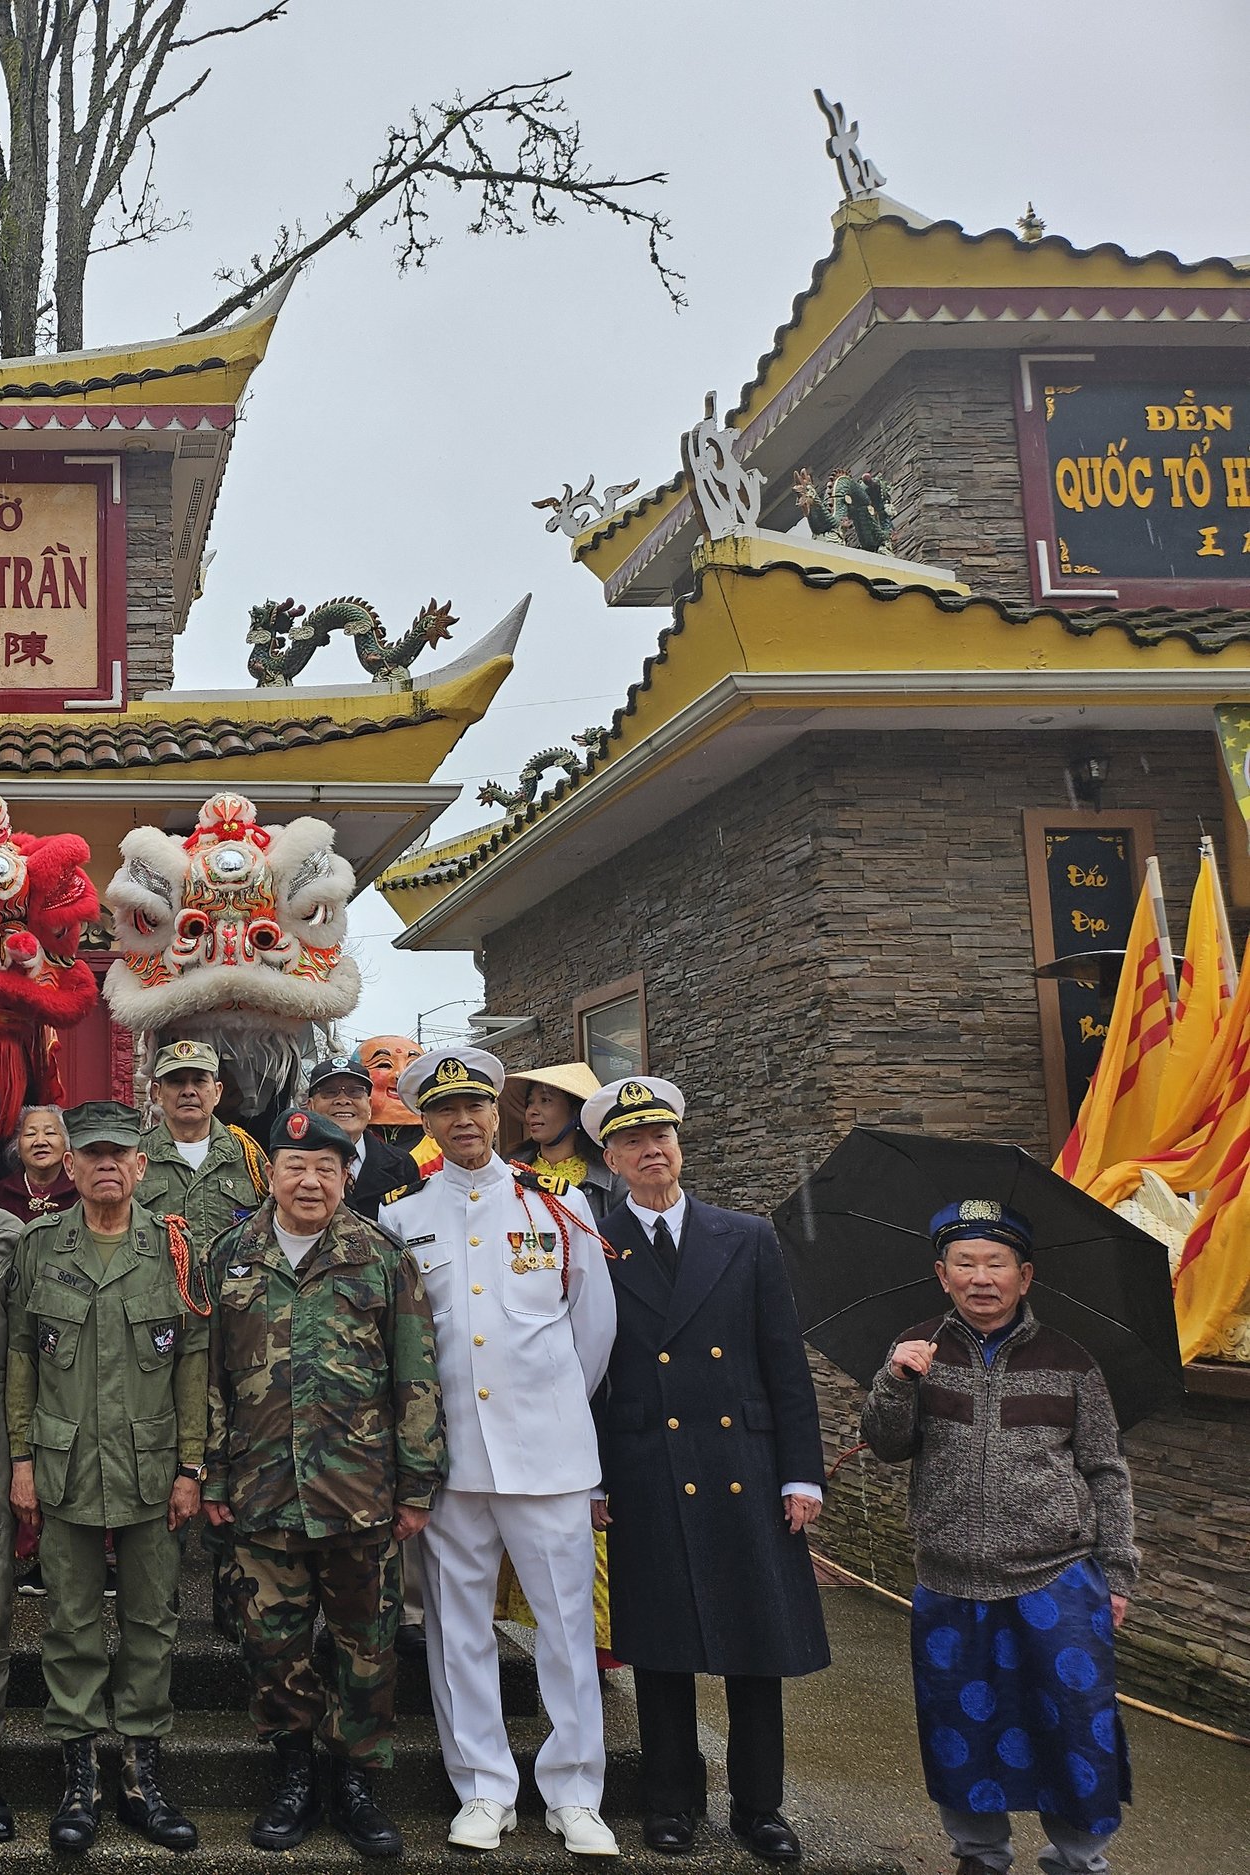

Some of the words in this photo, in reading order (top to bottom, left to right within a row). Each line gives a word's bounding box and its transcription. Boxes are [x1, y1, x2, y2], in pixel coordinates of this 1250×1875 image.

[1145, 388, 1233, 431] ĐỀN
[1055, 437, 1155, 513] QUỐC
[1162, 436, 1211, 508] TỔ
